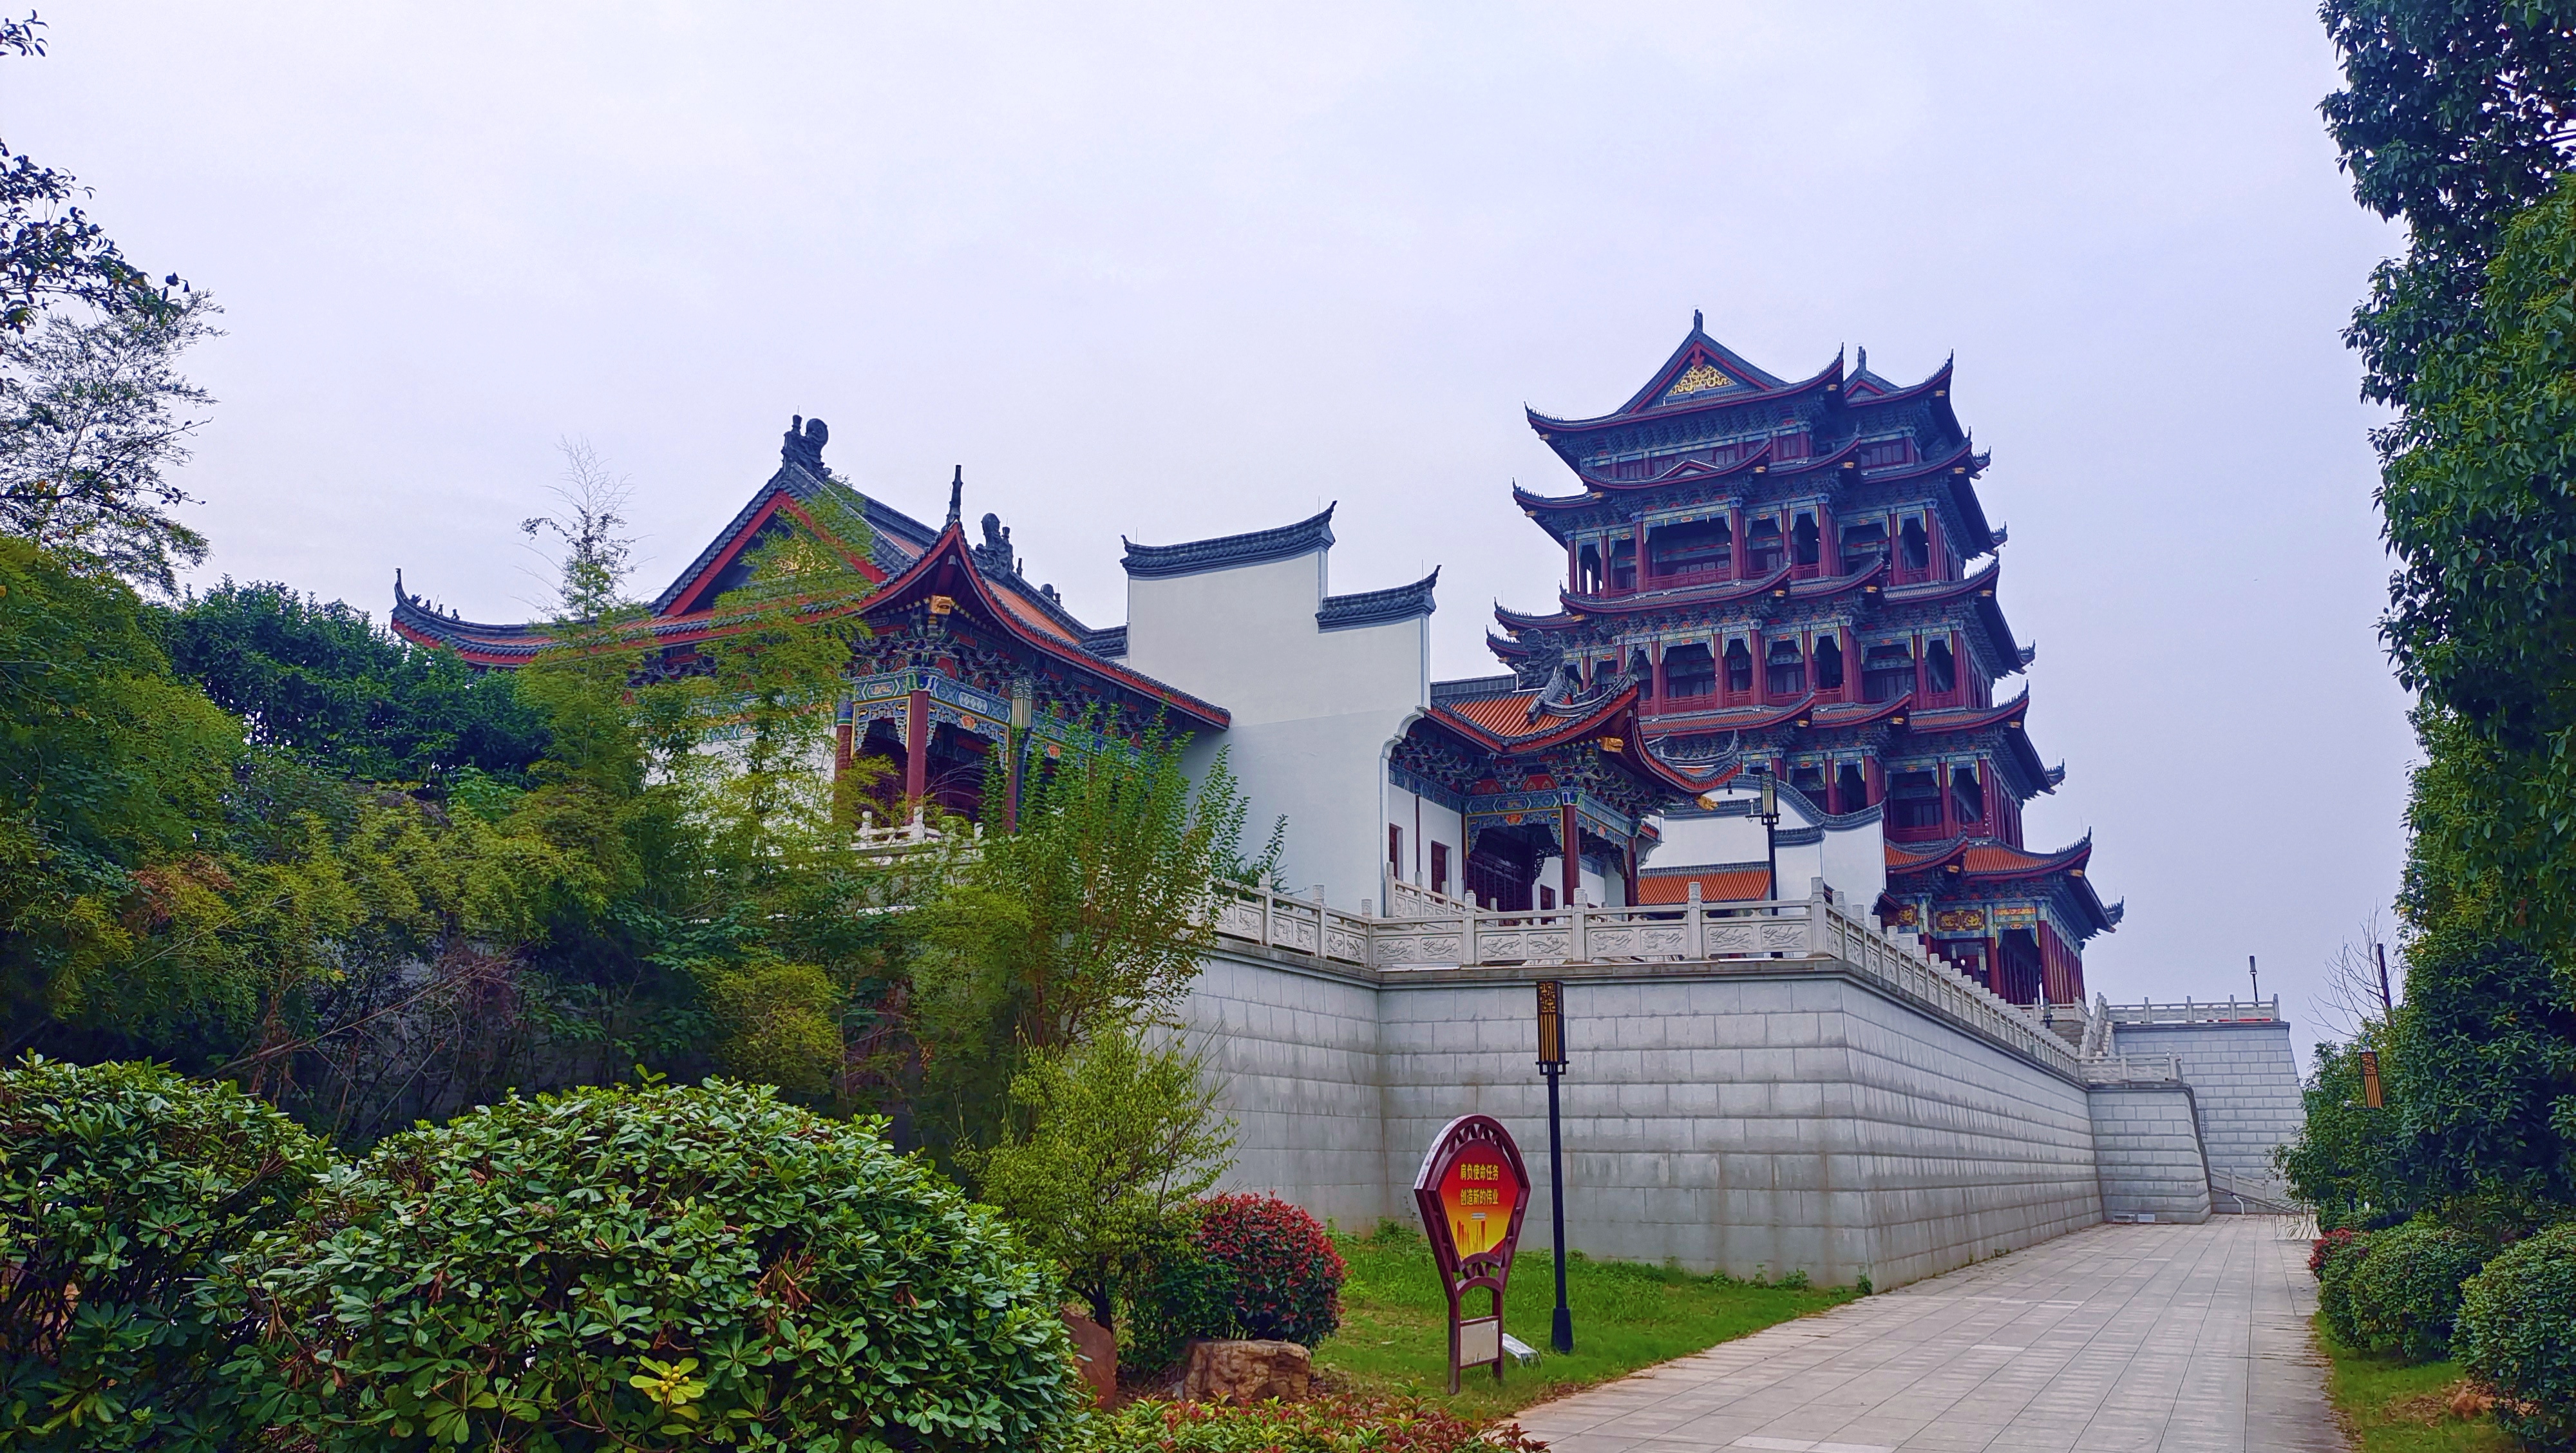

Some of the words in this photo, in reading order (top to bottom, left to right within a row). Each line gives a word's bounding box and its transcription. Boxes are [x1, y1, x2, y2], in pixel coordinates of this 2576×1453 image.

[1460, 1163, 1499, 1181] 肩负使命任务
[1460, 1188, 1499, 1205] 创造新的伟业
